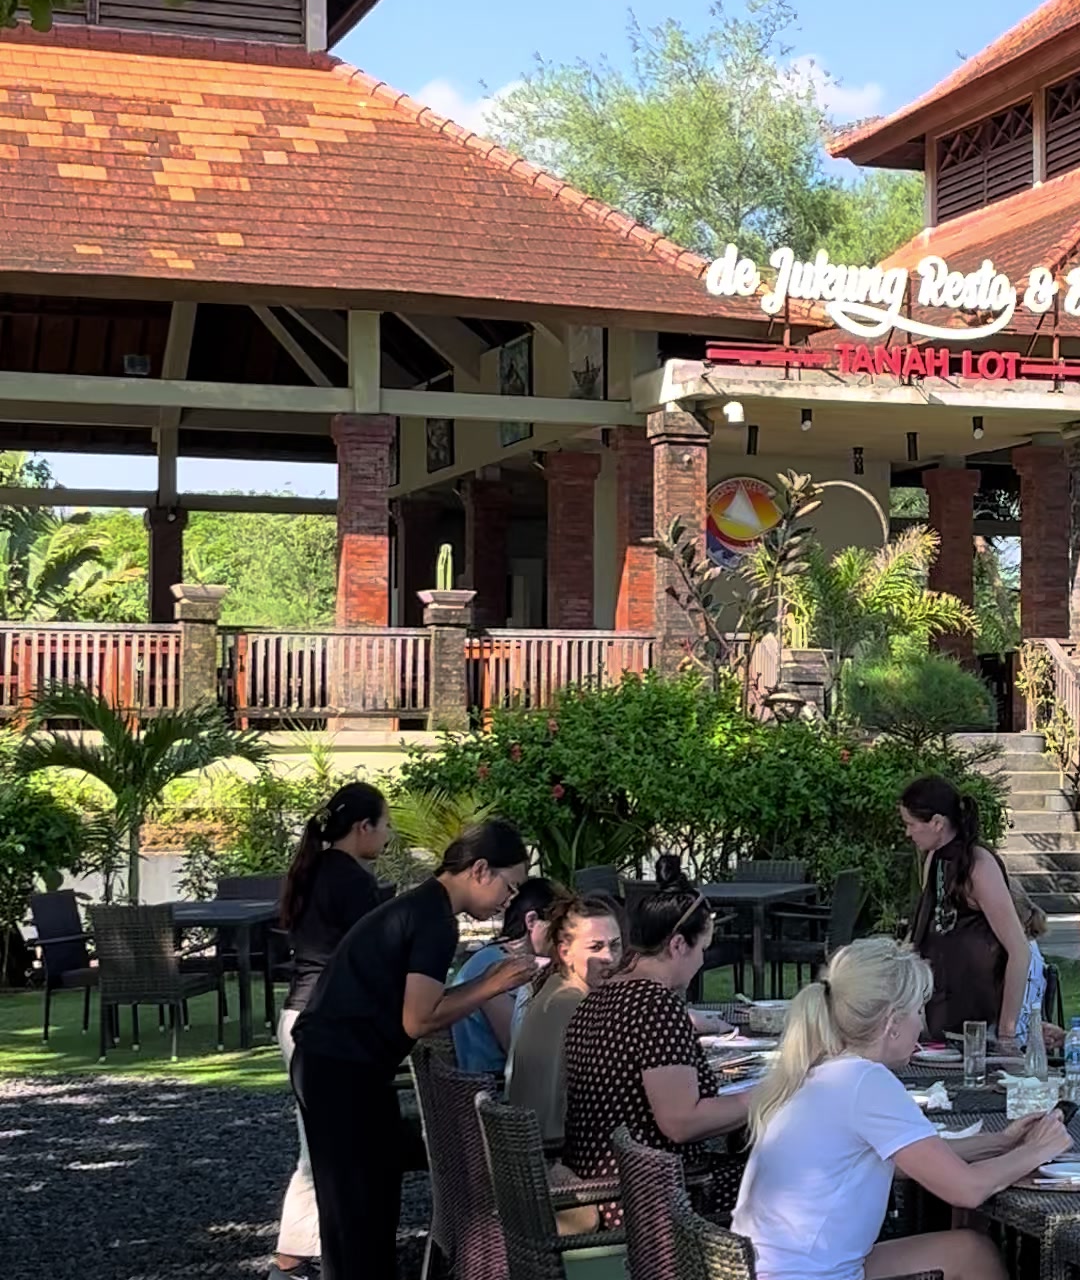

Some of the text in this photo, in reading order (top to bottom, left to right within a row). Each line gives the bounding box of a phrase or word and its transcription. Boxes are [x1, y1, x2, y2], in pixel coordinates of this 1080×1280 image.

[706, 243, 760, 296] de
[761, 247, 909, 337] Jukung
[917, 255, 1017, 312] Resto
[1024, 267, 1059, 313] &
[834, 343, 1020, 381] TANAH LOT
